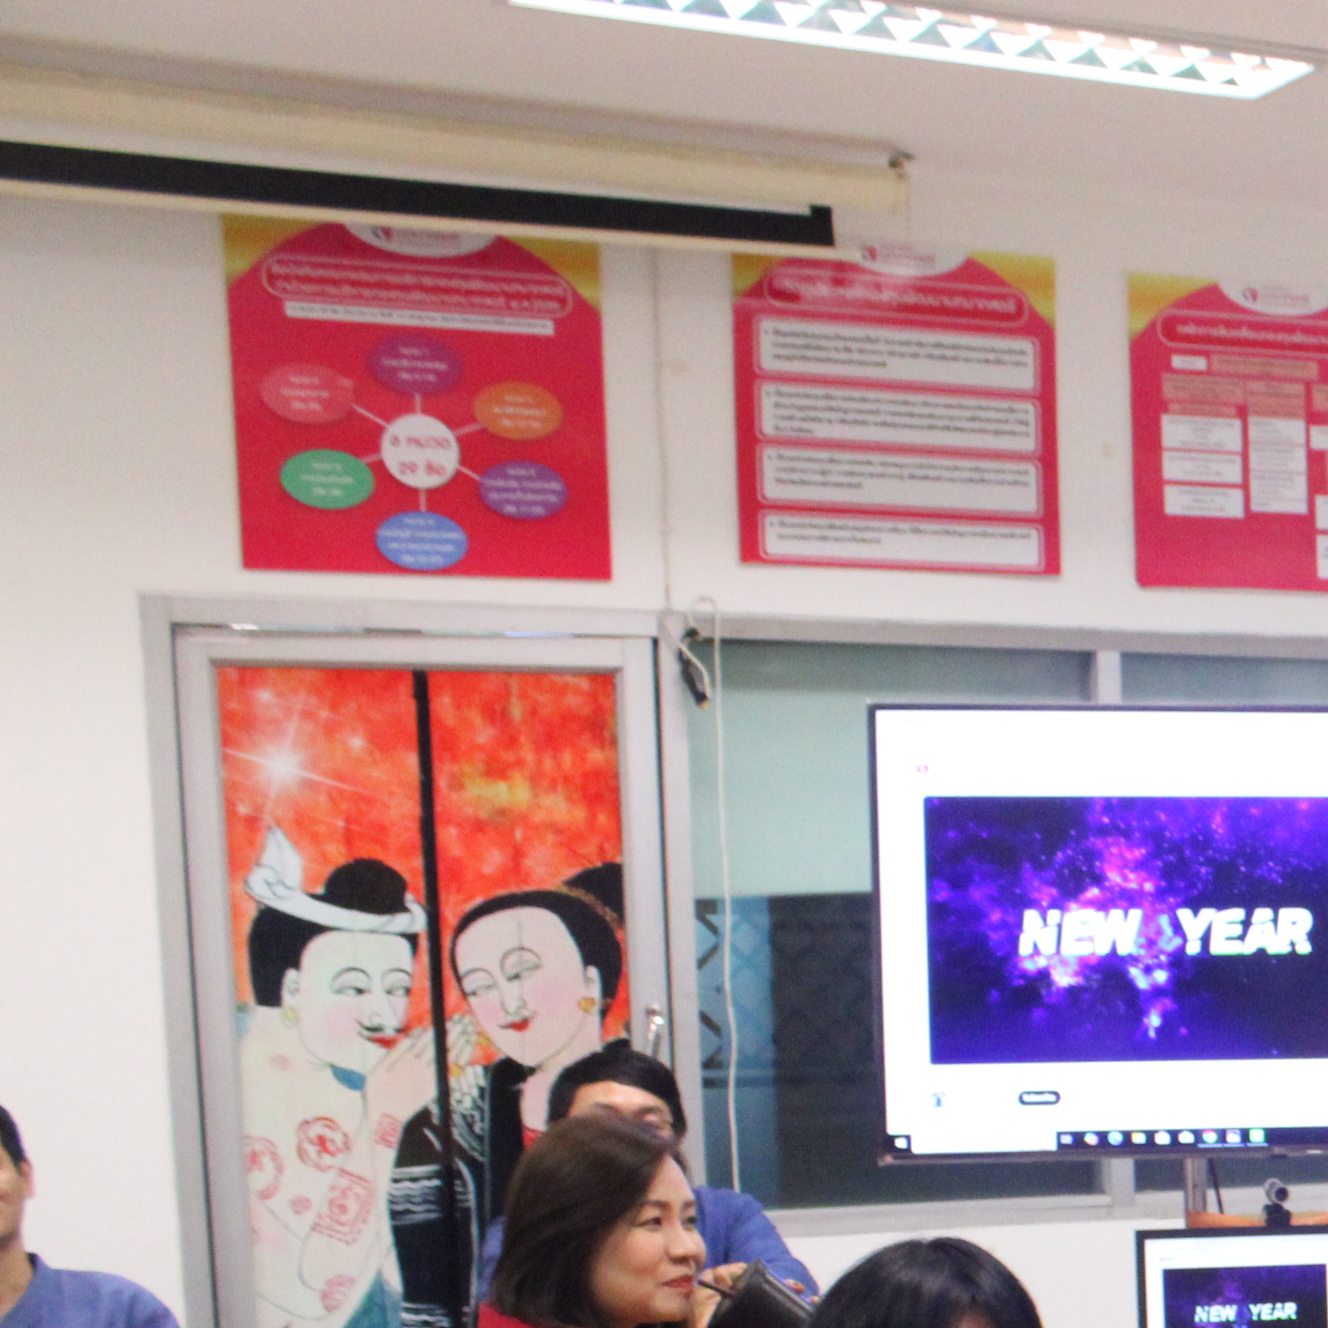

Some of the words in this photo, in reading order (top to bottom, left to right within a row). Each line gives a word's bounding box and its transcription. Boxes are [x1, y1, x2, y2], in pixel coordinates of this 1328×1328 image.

[1018, 908, 1143, 956] NEW
[1176, 907, 1314, 956] YEAR
[1194, 1304, 1238, 1323] NEW
[1248, 1302, 1299, 1321] YEAR
